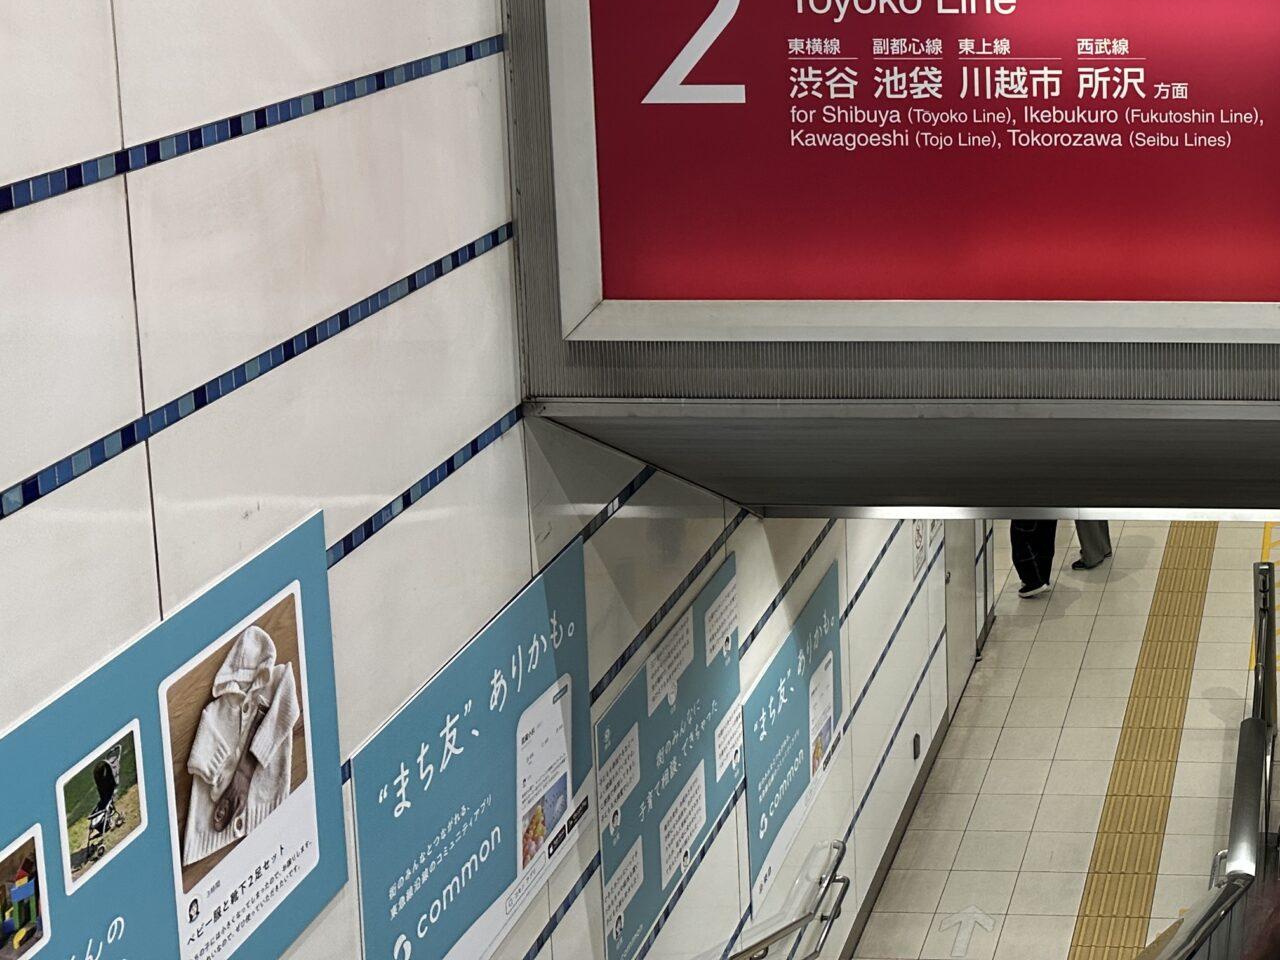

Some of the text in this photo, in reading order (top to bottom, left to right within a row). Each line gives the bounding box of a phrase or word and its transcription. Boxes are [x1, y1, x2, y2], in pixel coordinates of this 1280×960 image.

[787, 37, 1130, 56] 東横線 副都心線 東上線 西武線
[789, 66, 1189, 100] 渋谷 池袋 川越市 所沢 方面
[790, 105, 817, 123] for
[822, 105, 902, 128] Shibuya
[973, 106, 1017, 127] Line),
[1024, 105, 1119, 124] Ikebukuro
[1125, 106, 1215, 125] (Fukutoshin
[1220, 107, 1264, 127] Line),
[790, 129, 1232, 151] Kawagoeshi (Tojo Line), Tokorozawa (Seibu Lines)
[768, 748, 804, 817] common
[417, 826, 501, 939] common
